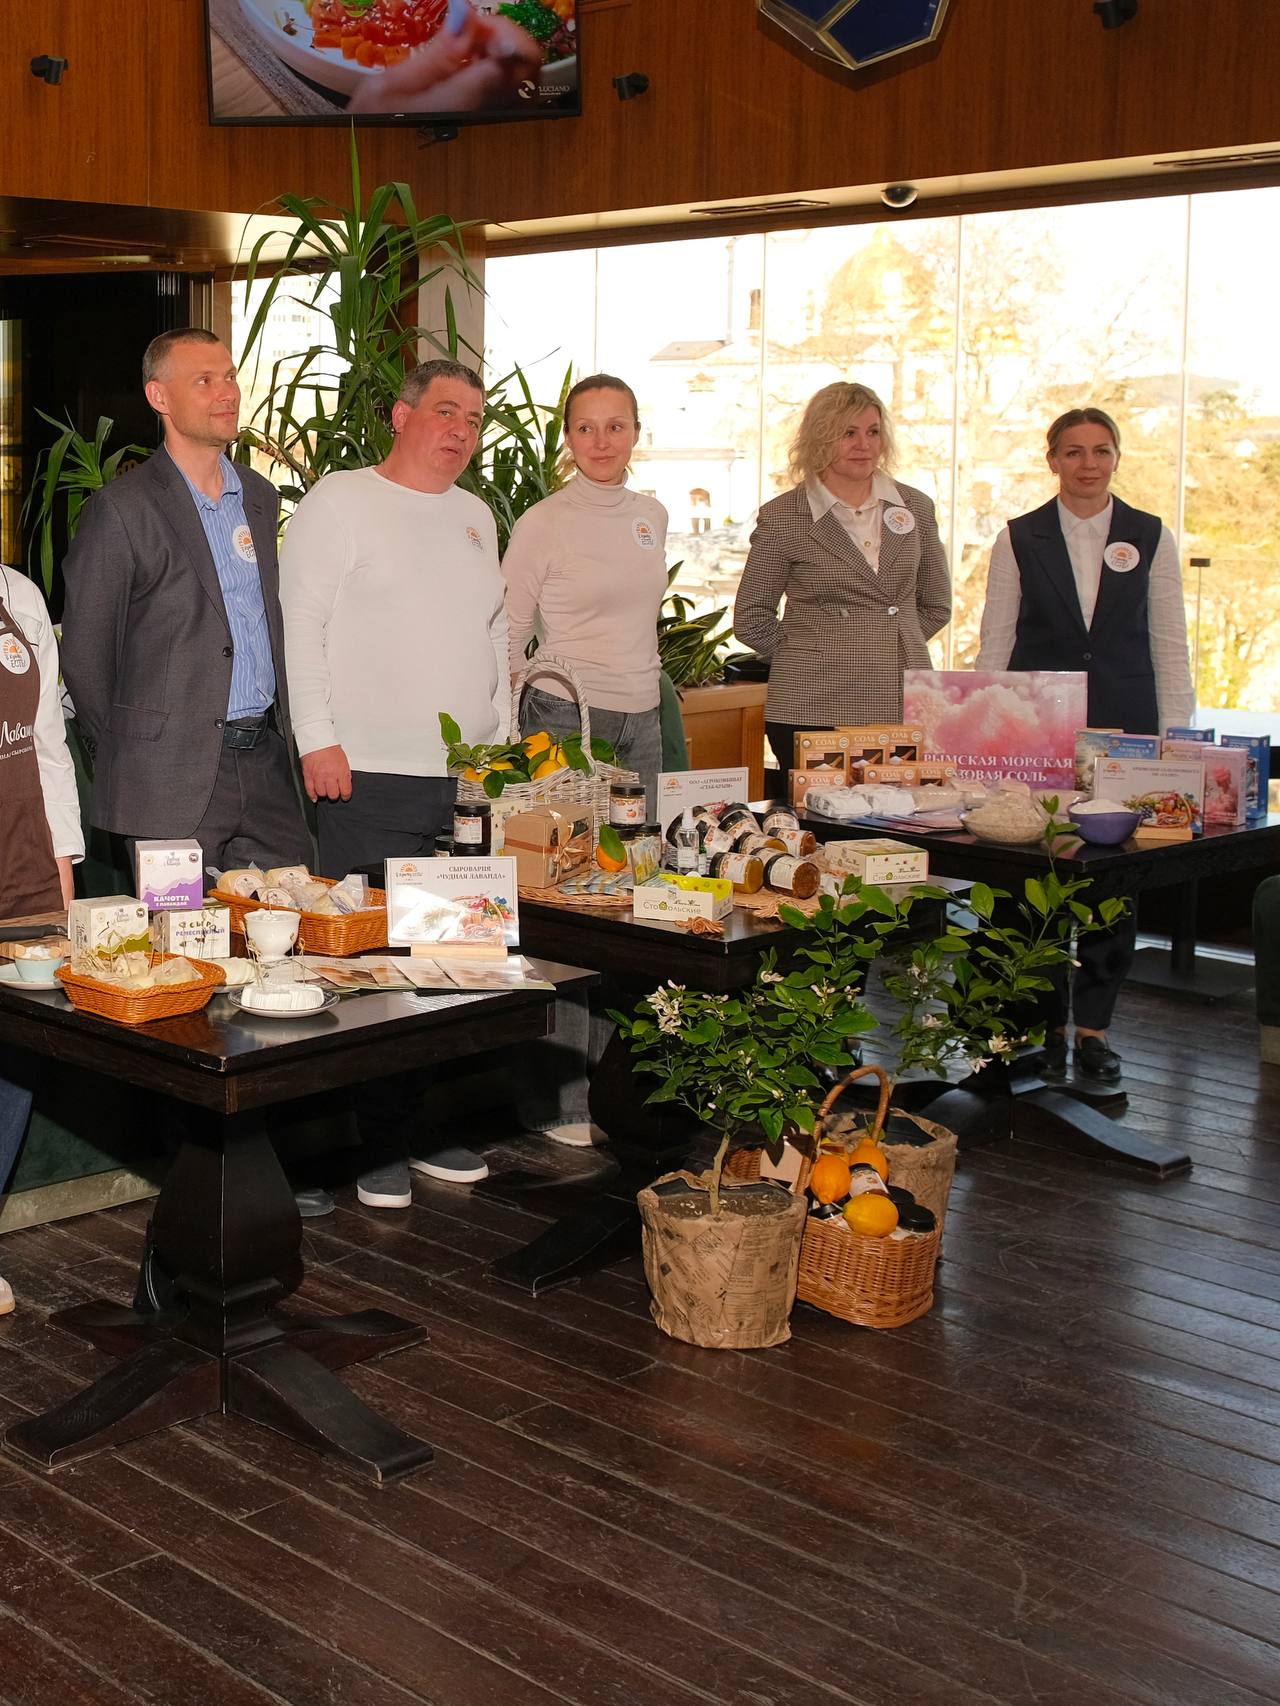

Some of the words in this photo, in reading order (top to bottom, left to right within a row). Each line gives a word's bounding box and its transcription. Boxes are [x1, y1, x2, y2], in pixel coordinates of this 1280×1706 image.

[854, 735, 876, 743] СОЛЬ
[891, 732, 909, 740] ОЛЬ
[924, 753, 997, 767] РЫМСКАЯ
[1001, 756, 1073, 769] МОРСКАЯ
[1007, 771, 1048, 783] СОЛЬ
